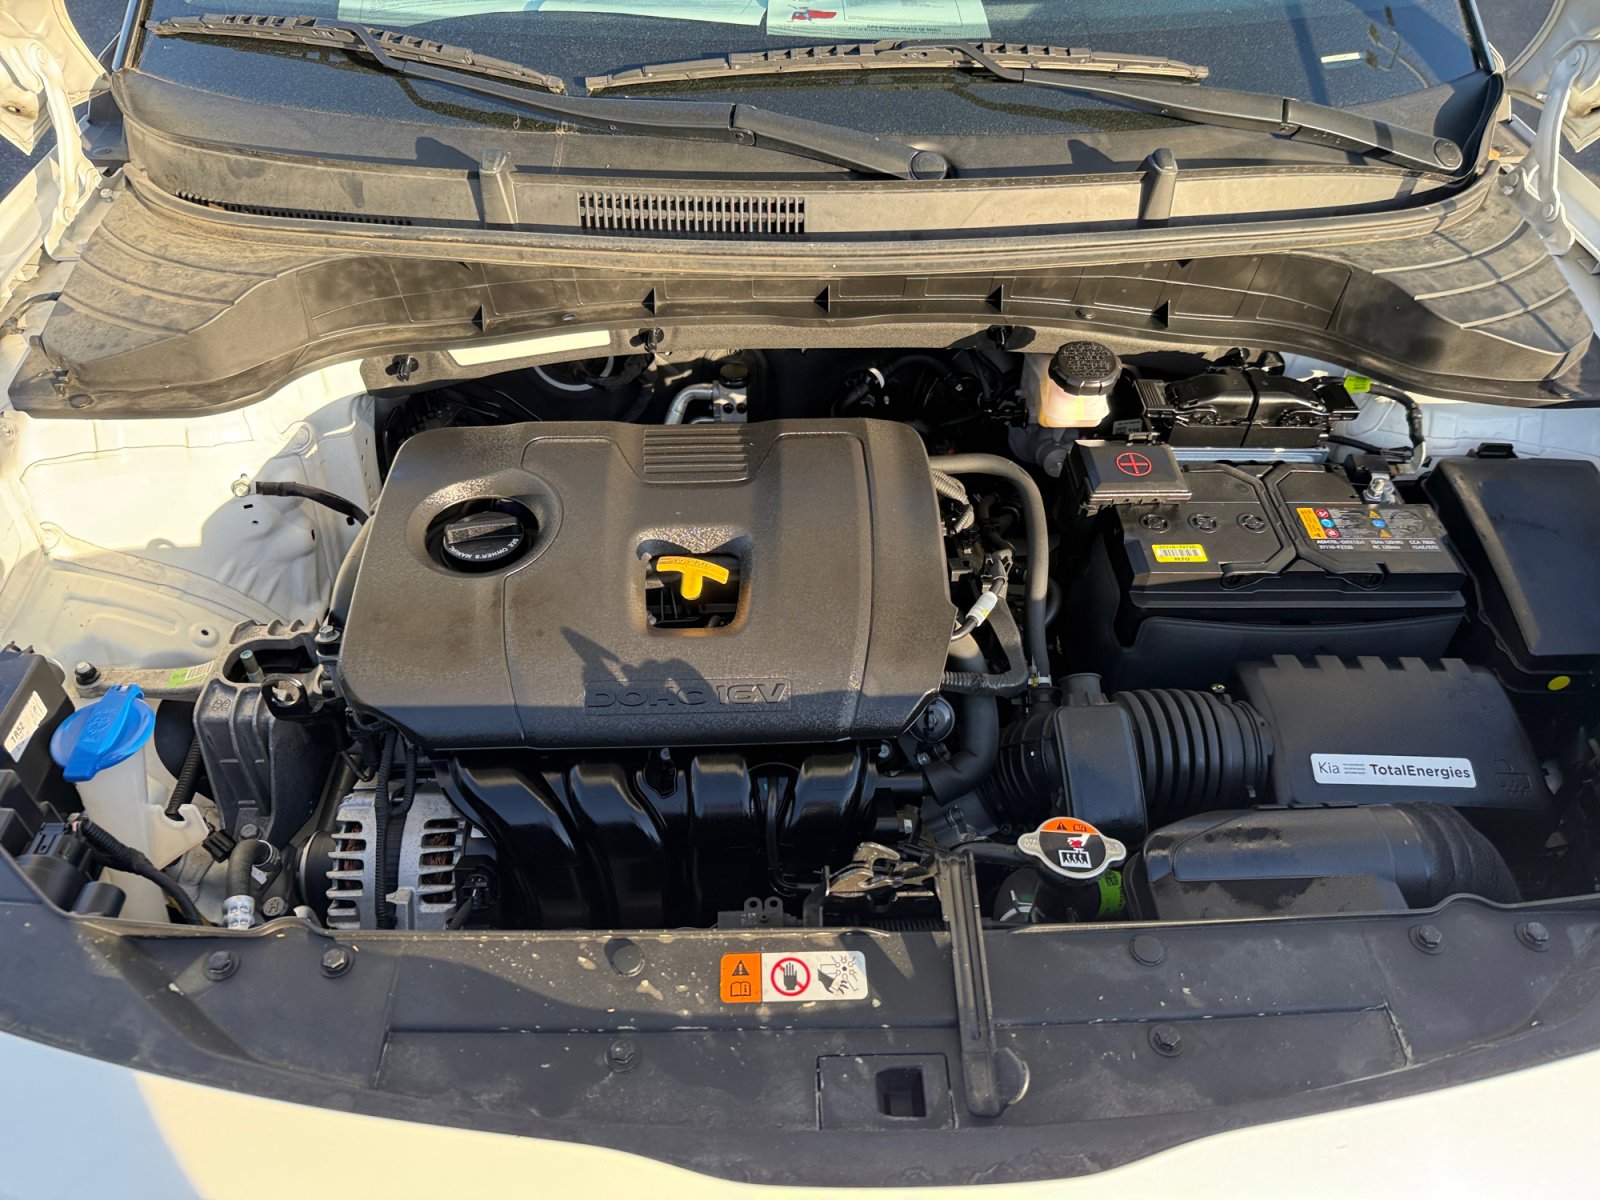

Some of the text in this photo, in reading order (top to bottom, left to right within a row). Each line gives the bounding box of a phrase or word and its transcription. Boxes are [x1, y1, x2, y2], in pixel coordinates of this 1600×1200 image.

[448, 538, 519, 559] SEE OWNER'S MANUAL
[587, 683, 786, 708] DOHC 16V
[1317, 761, 1340, 775] Kia
[1369, 763, 1471, 780] TotalEnergies
